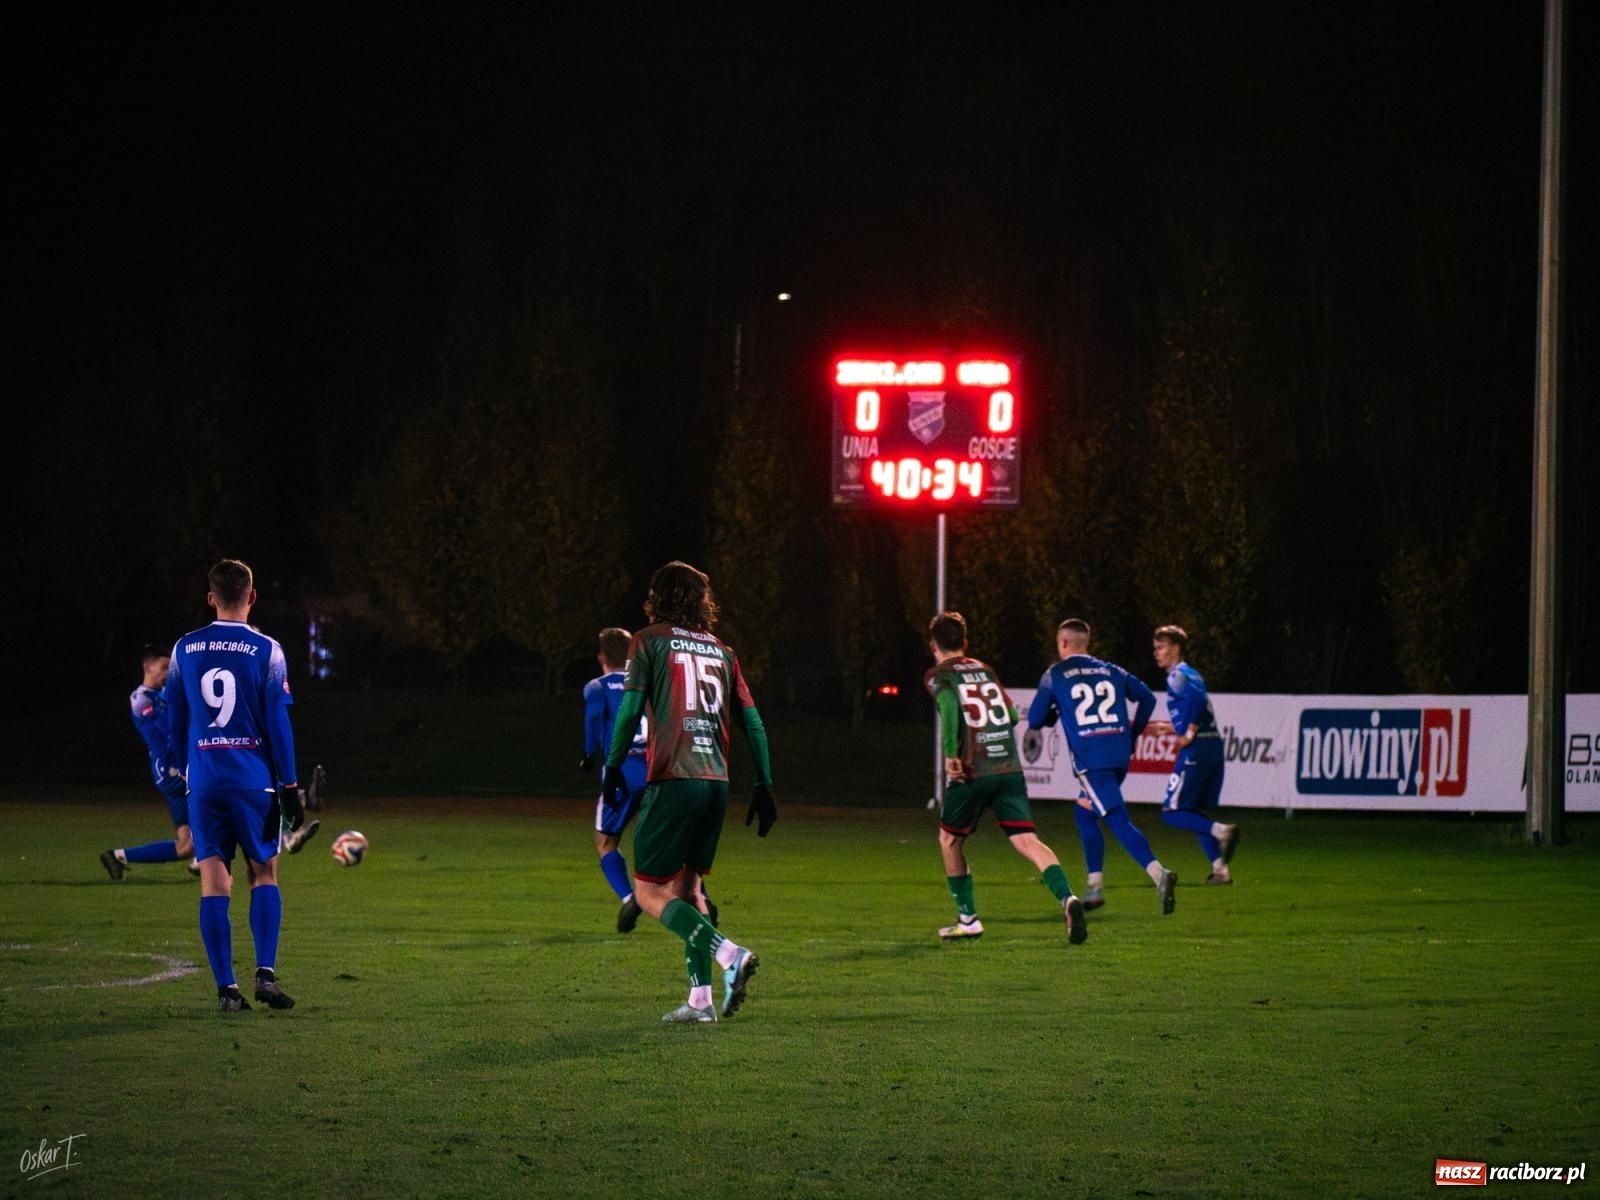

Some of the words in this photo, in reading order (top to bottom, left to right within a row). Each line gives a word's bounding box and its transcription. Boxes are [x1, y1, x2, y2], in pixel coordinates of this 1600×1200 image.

[856, 390, 880, 432] 0
[989, 391, 1014, 433] 0
[842, 436, 879, 459] UNIA
[871, 458, 983, 500] 40:34
[185, 641, 206, 654] UNIA
[209, 640, 258, 656] RACIBÓRZ
[670, 639, 723, 658] CHABAN
[200, 667, 236, 728] 9
[675, 652, 724, 714] 15
[1071, 680, 1119, 726] 22
[958, 682, 1011, 728] 53
[1301, 708, 1461, 796] nowiny.pl
